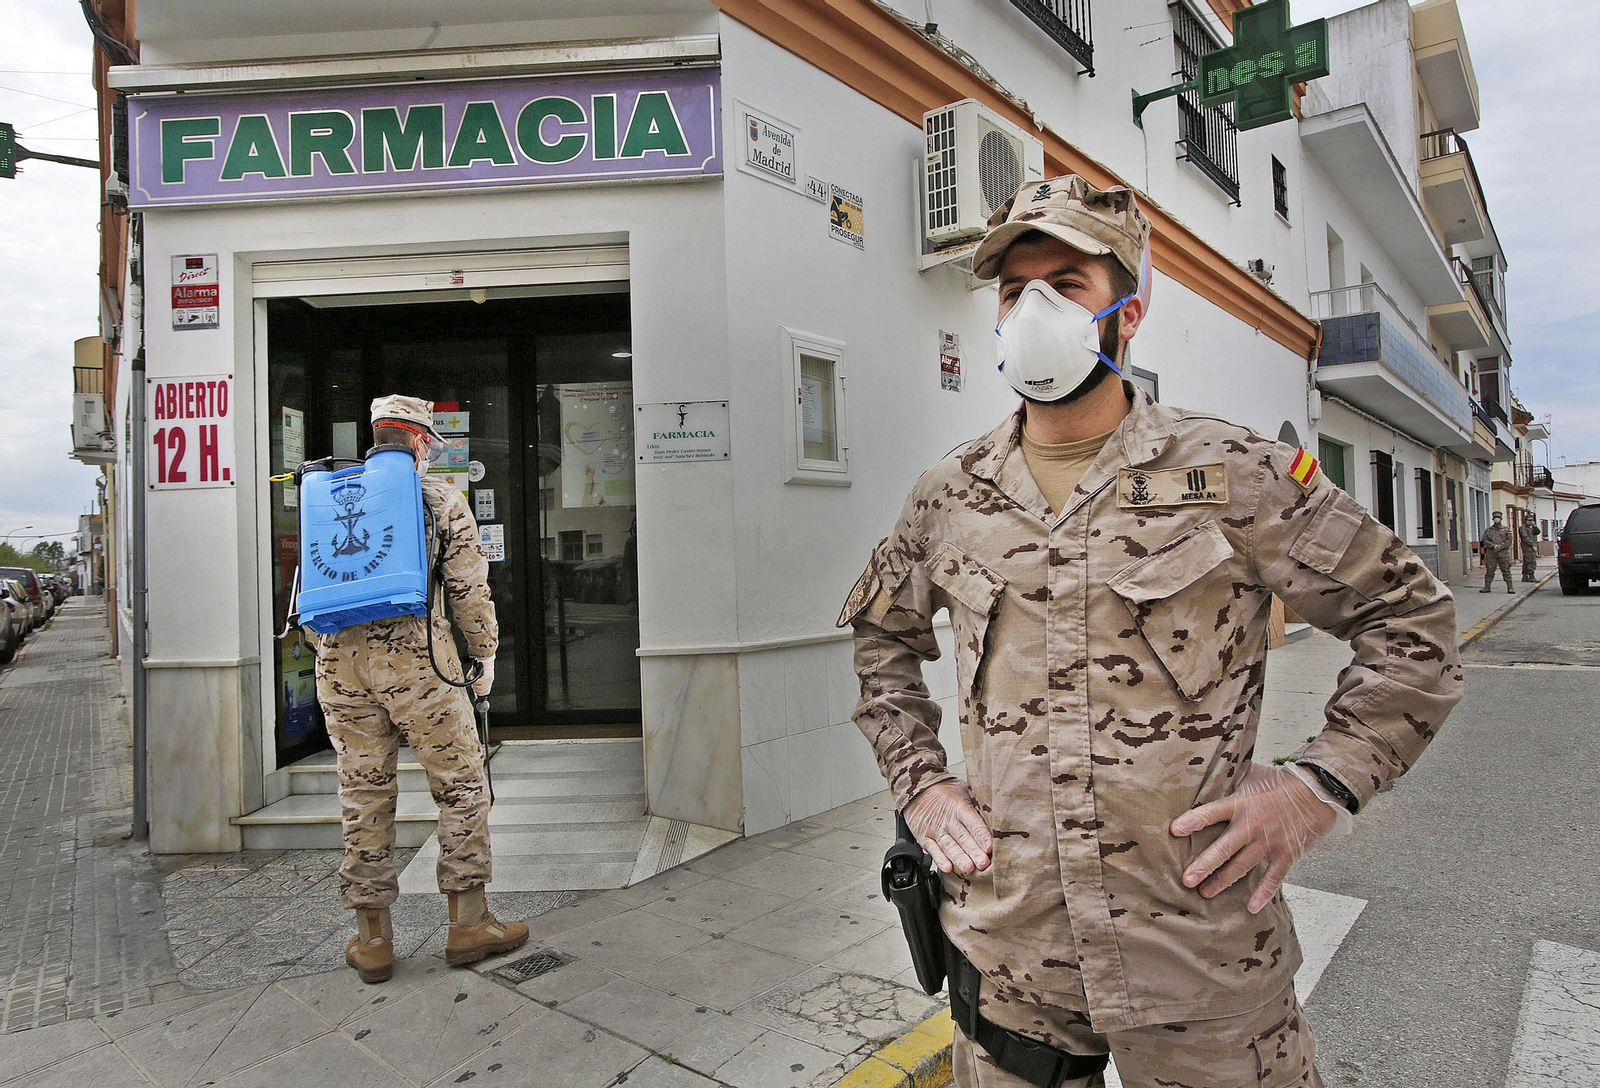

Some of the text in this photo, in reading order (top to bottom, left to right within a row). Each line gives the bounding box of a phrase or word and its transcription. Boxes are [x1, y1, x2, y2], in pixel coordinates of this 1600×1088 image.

[160, 91, 692, 185] FARMACIA
[762, 125, 791, 147] Avenida
[772, 143, 782, 157] de
[752, 148, 791, 176] Madrid
[830, 183, 864, 205] CONECTADA
[830, 224, 864, 245] PROSEGUR
[178, 266, 212, 284] Direct
[172, 286, 218, 299] Alarma
[154, 380, 228, 420] ABIERTO
[652, 430, 716, 440] FARMACIA
[153, 426, 187, 483] 12
[199, 424, 230, 483] H.
[1181, 492, 1205, 501] MESA
[309, 525, 393, 582] TERCIO DE ARMADA
